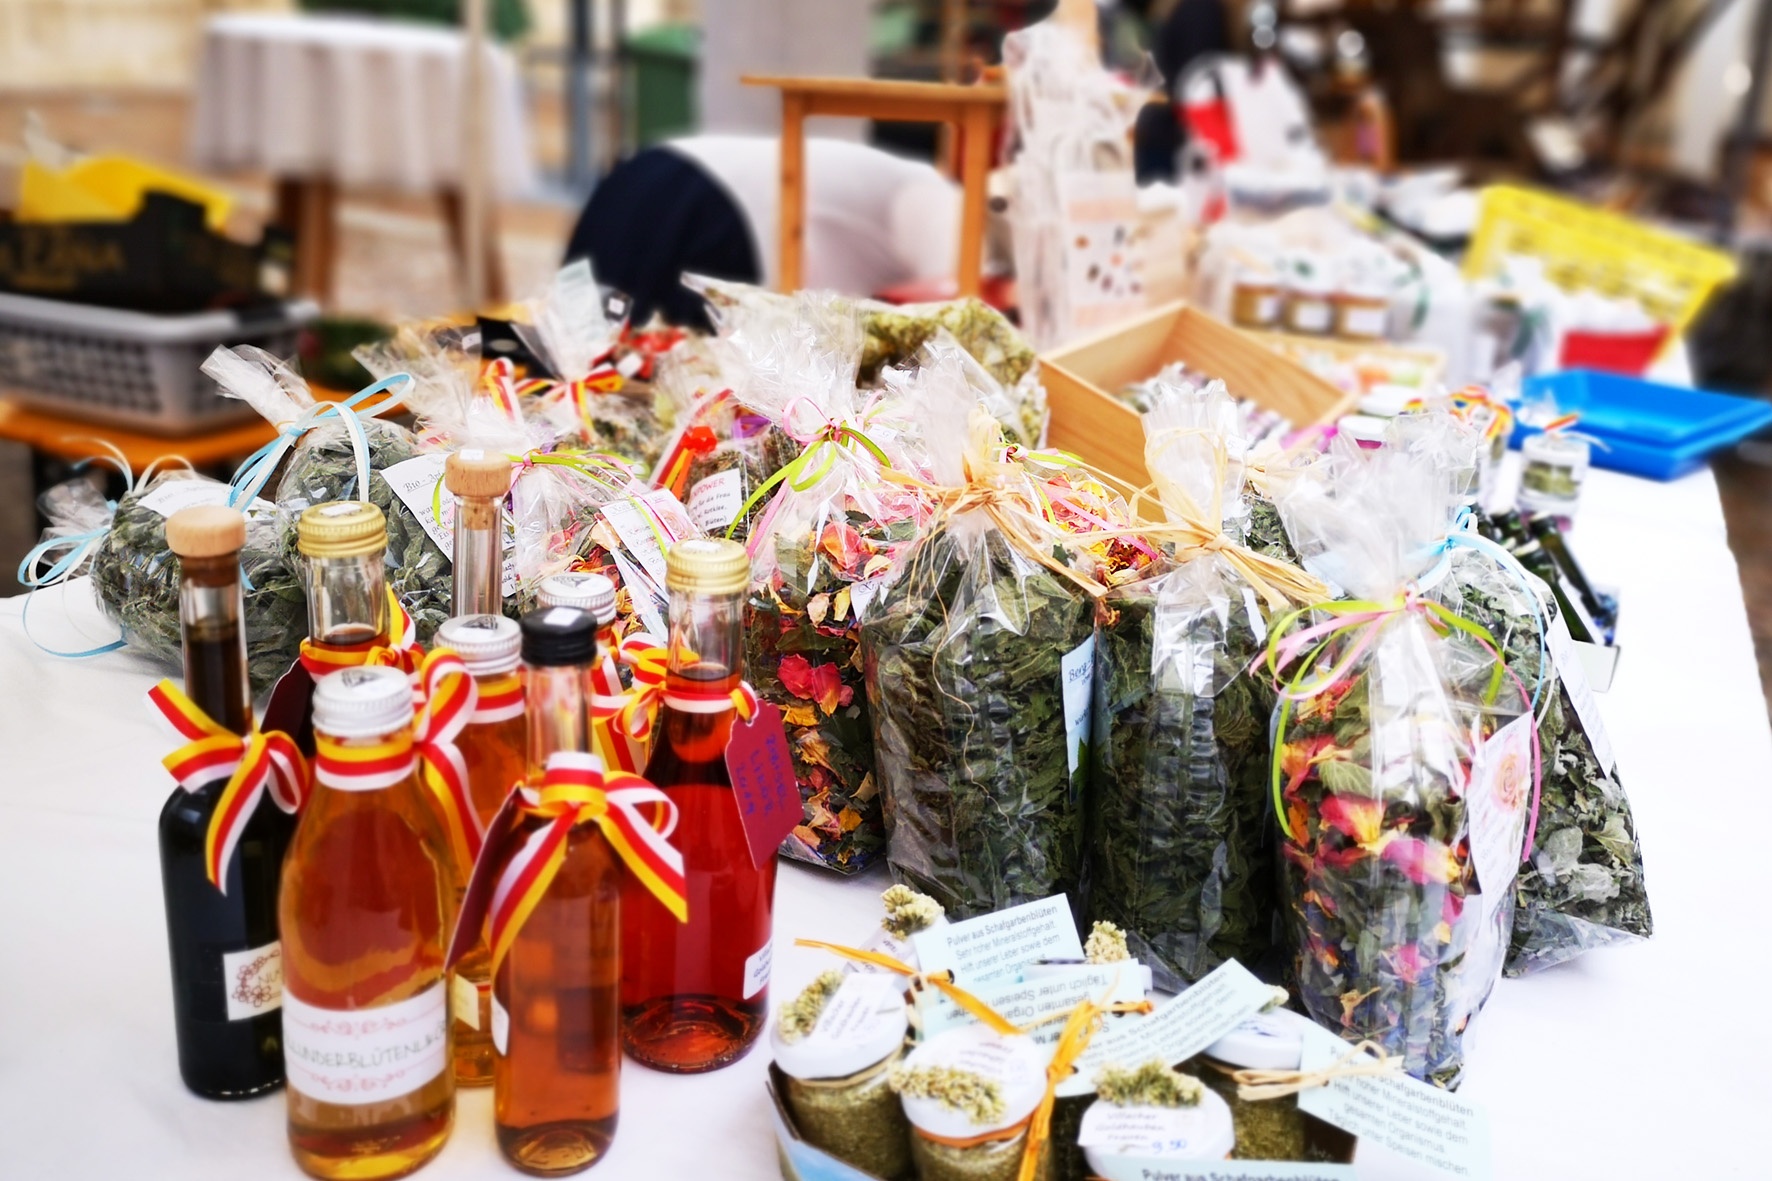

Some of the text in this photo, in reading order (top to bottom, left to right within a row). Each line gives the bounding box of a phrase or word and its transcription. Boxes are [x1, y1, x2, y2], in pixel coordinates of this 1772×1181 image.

[972, 929, 985, 940] aus
[985, 905, 1058, 934] Schafgarbenblüten
[992, 974, 1108, 1007] Täglich unter Speisen
